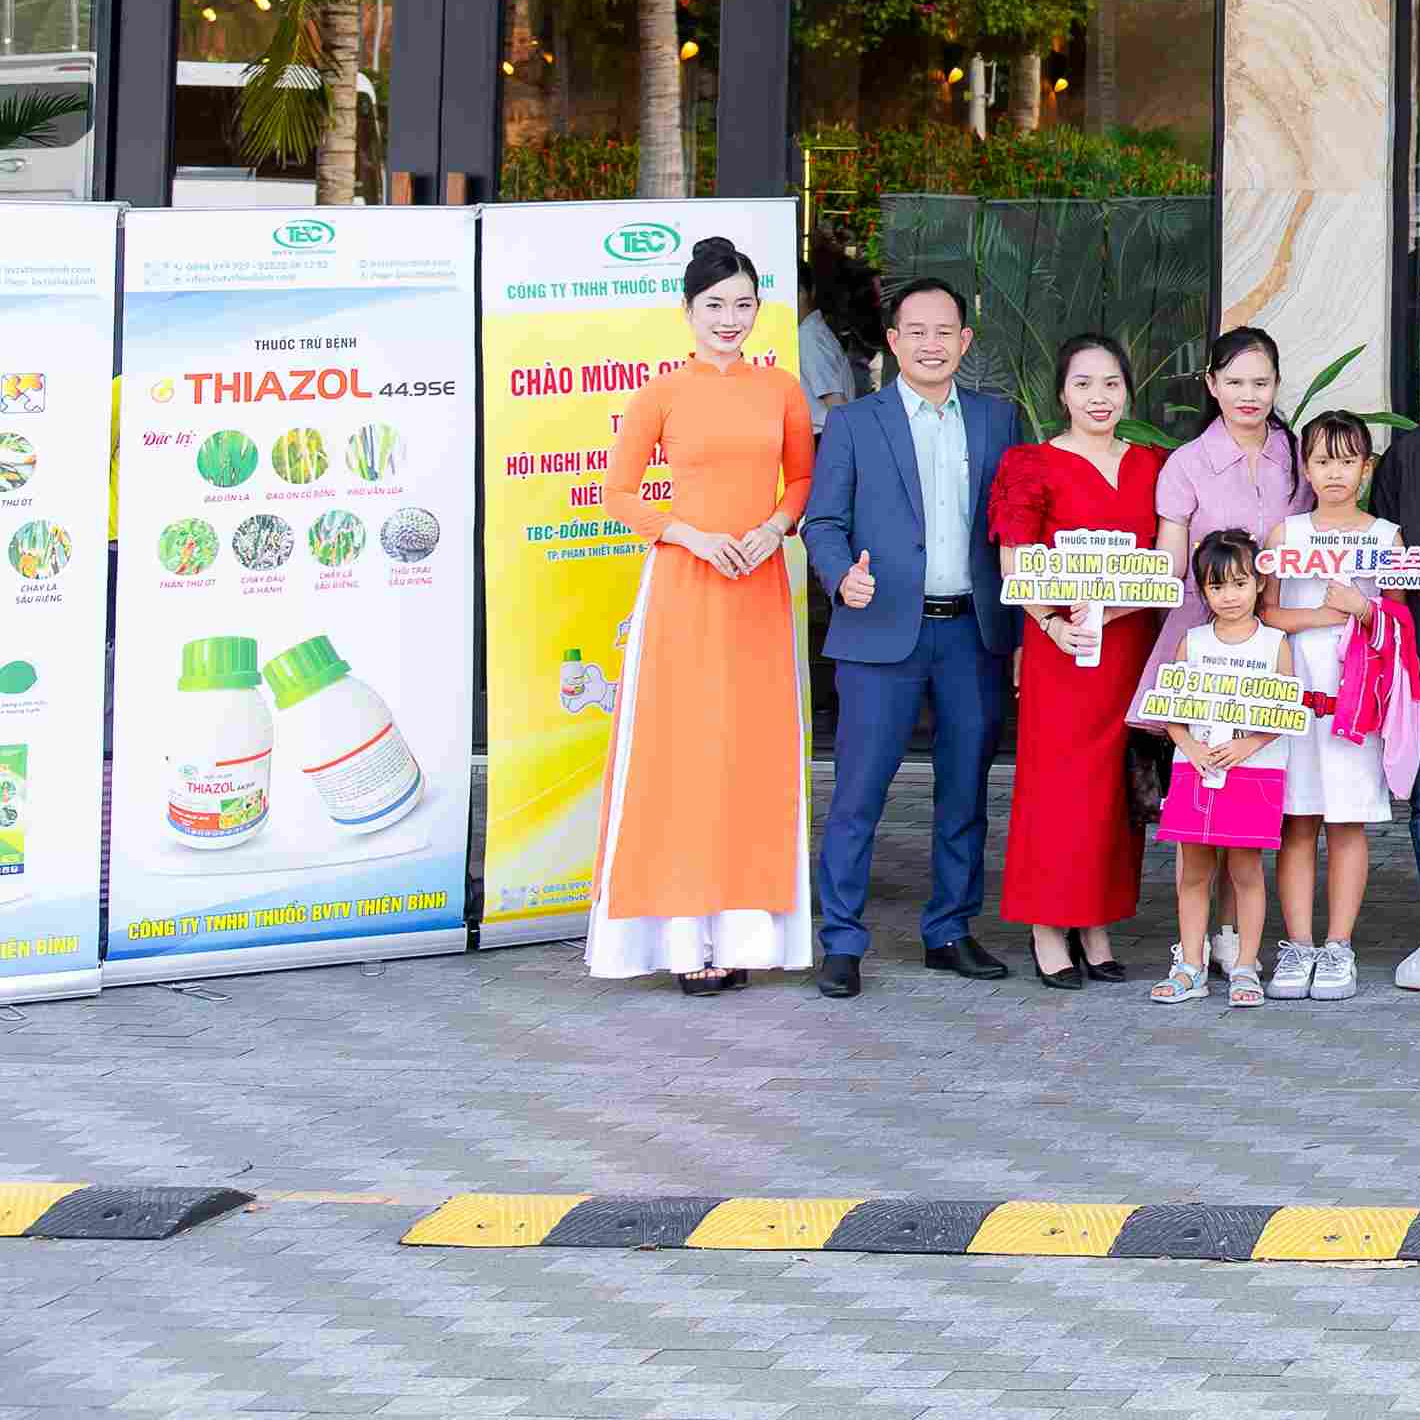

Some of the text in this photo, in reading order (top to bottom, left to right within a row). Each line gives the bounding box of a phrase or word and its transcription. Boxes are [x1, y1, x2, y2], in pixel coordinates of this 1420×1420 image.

[507, 274, 657, 301] CÔNG TY TNHH THUỐC
[184, 368, 373, 405] THIAZOL
[511, 362, 573, 397] CHÀO
[507, 452, 534, 480] HỘI
[540, 450, 581, 477] NGHỊ
[571, 481, 603, 506] NIÊ
[563, 548, 586, 560] PHAN
[1018, 550, 1169, 577] BỘ 3 KIM CƯƠNG
[1280, 549, 1348, 575] RAY
[1005, 581, 1034, 601] AN
[1038, 578, 1077, 602] TÂM
[1160, 668, 1300, 702] BỘ 3 KIM CƯƠNG
[1144, 696, 1170, 716] AN
[1172, 696, 1211, 721] TÂM
[186, 780, 236, 795] THIAZOL
[128, 917, 176, 941] CÔNG
[179, 916, 199, 936] TY
[205, 911, 249, 933] TNHH
[254, 900, 307, 929] THUỐC
[311, 901, 352, 922] BVTV
[355, 893, 401, 918] THIÊN
